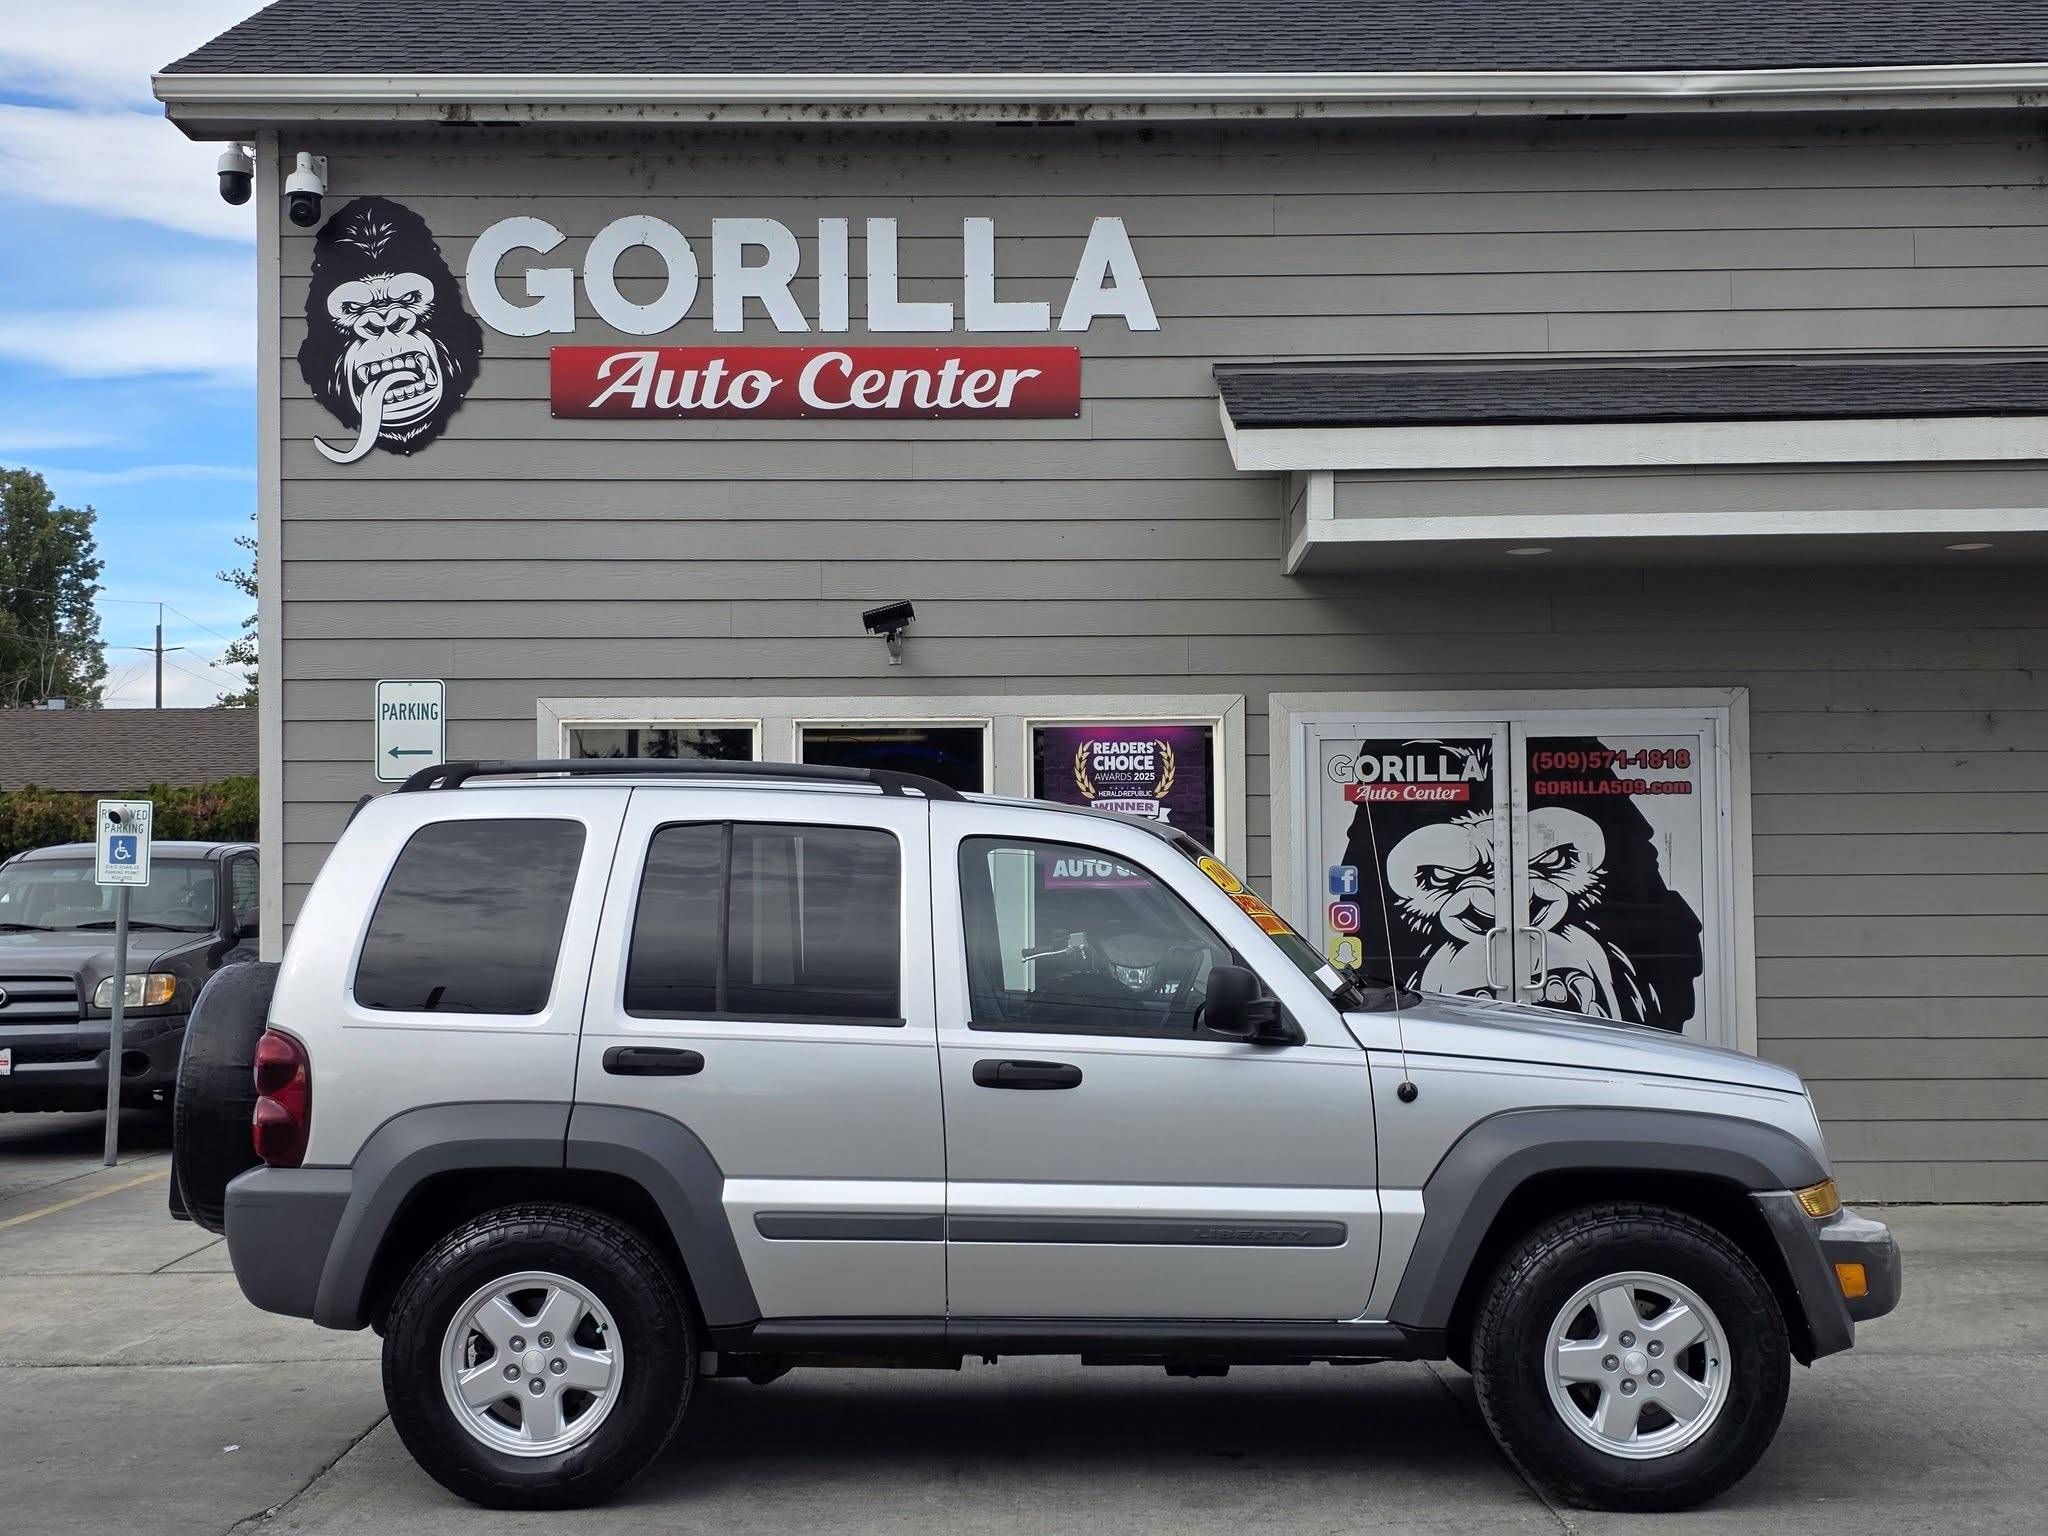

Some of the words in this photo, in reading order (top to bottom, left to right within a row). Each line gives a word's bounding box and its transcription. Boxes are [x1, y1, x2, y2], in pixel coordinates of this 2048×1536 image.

[466, 215, 1161, 337] GORILLA
[589, 350, 783, 411] Auto
[799, 351, 1042, 411] Center
[382, 703, 439, 720] PARKING
[1093, 741, 1157, 754] READERS'
[1093, 755, 1155, 771] CHOICE
[1327, 754, 1486, 784] GORILLA
[1532, 749, 1691, 773] (509)571-1818
[1094, 772, 1132, 781] AWARDS
[1133, 772, 1155, 781] 2025
[1355, 785, 1400, 800] Auto
[1403, 785, 1461, 800] Center
[1534, 778, 1692, 796] GORILLA509.com
[104, 822, 144, 834] PARKING
[1053, 859, 1113, 877] AUTO
[1194, 1229, 1311, 1241] LIBERTY
